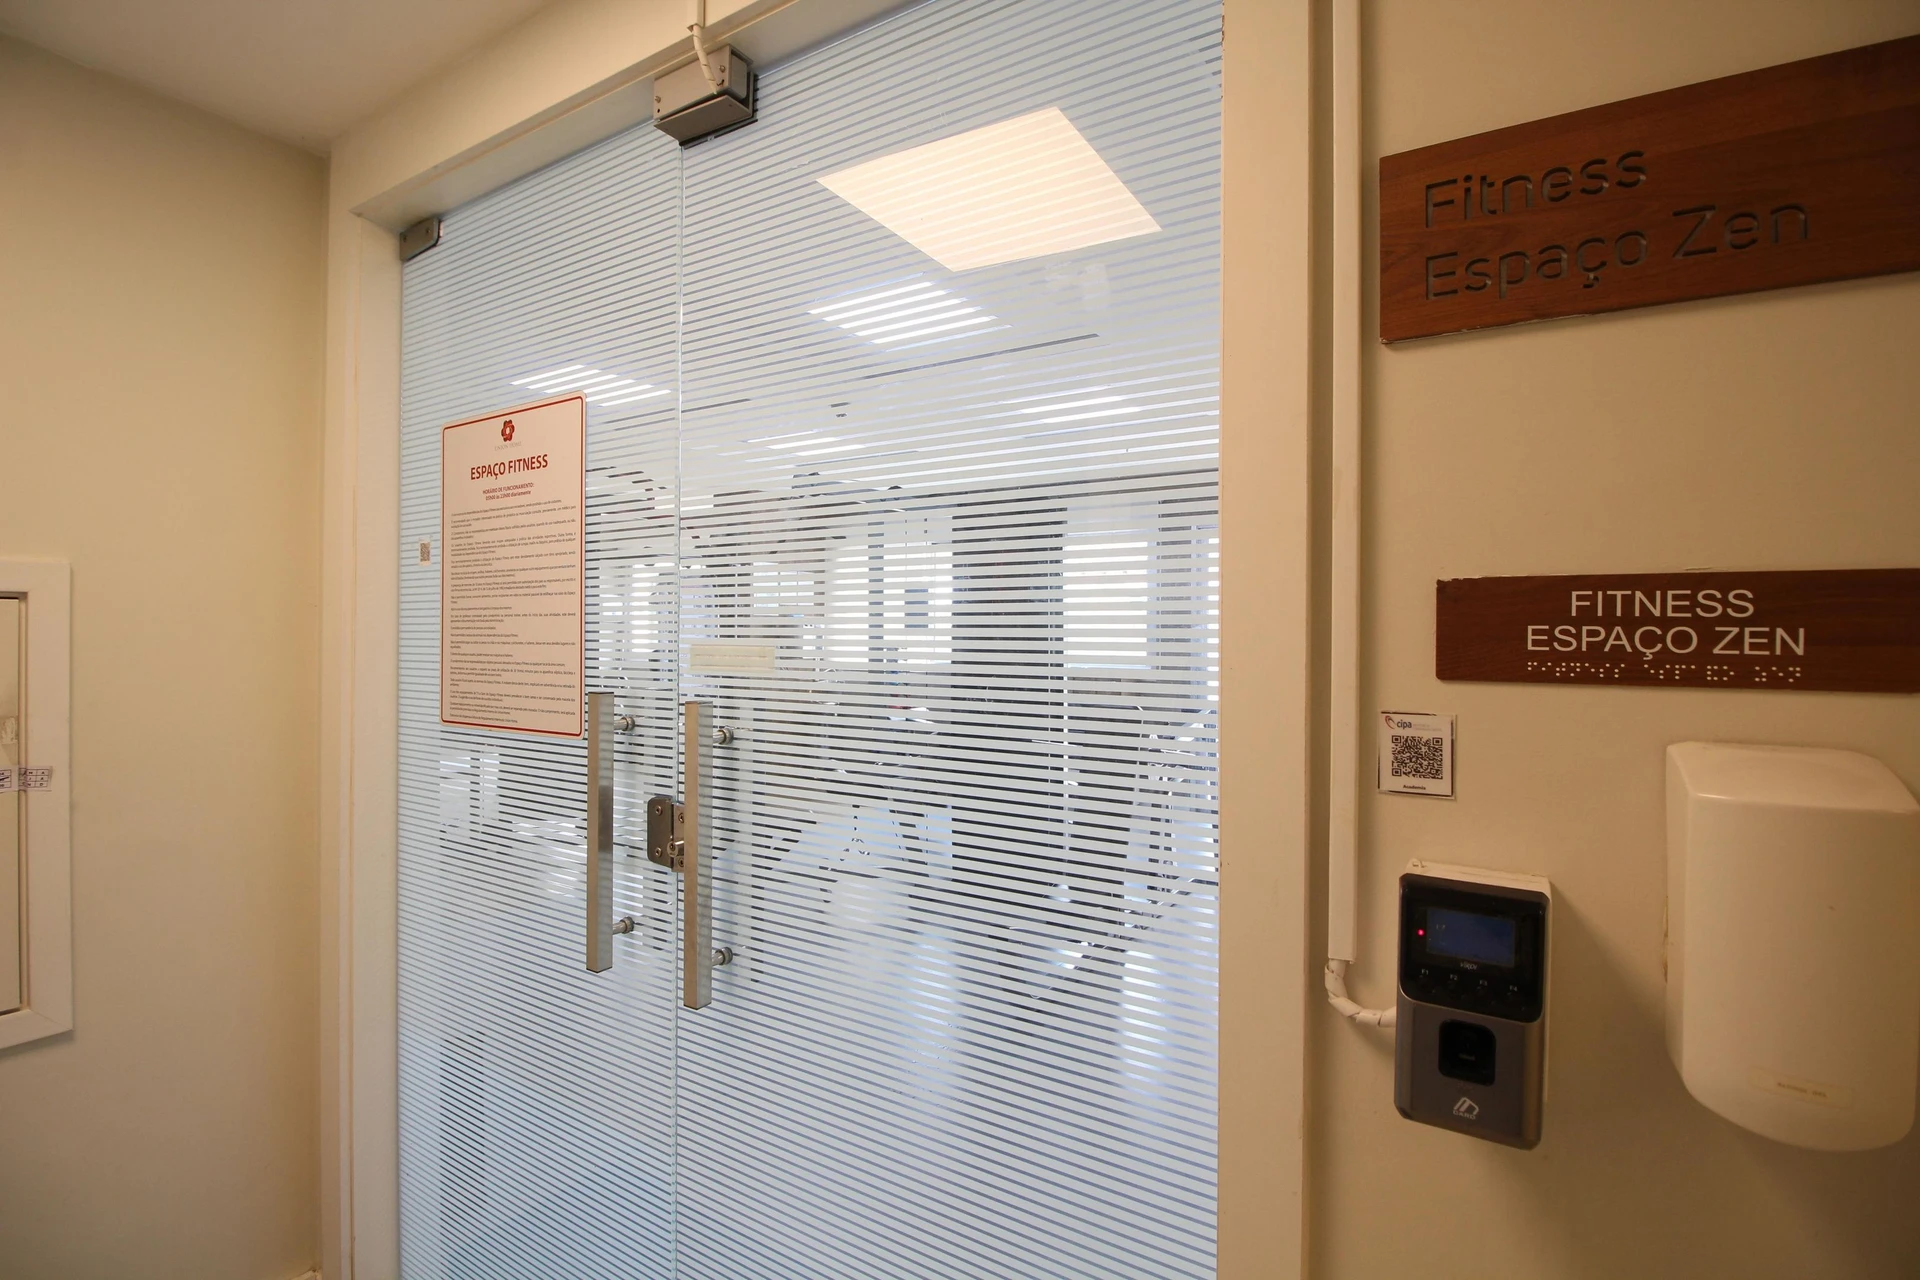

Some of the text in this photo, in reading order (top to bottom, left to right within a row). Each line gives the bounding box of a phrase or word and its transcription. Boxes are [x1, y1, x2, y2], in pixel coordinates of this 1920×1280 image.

[1425, 150, 1647, 228] Fitness
[1425, 203, 1809, 300] Espaço Zen
[470, 453, 549, 480] ESPAÇO FITNESS
[1570, 588, 1755, 618] FITNESS
[1526, 625, 1806, 660] ESPAÇO ZEN
[1396, 719, 1412, 730] cipa
